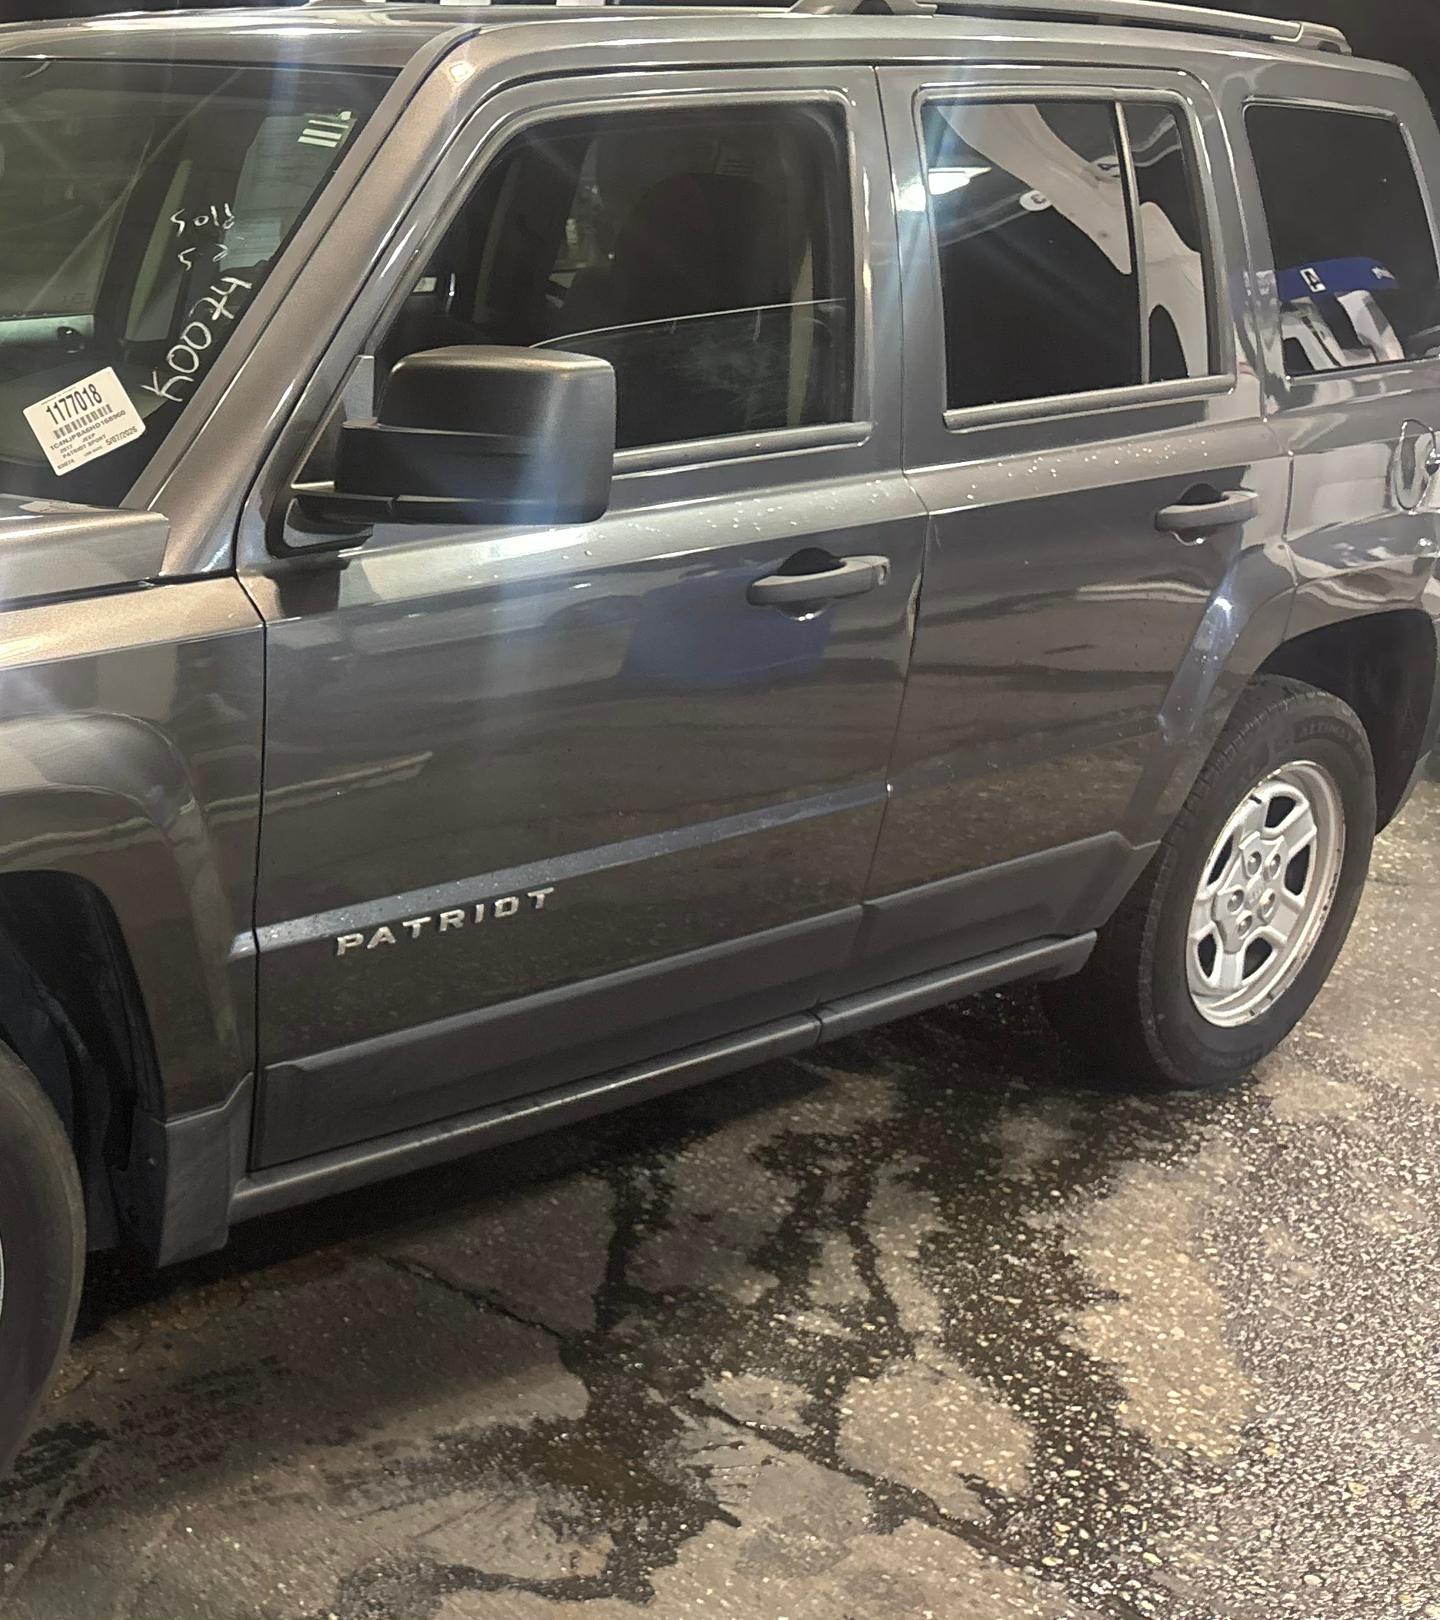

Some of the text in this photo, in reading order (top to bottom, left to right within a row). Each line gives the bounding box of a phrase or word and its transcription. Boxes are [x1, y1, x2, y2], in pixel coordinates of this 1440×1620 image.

[139, 276, 252, 402] K0074
[46, 383, 103, 425] 1177018
[62, 444, 87, 459] PATRIOT
[335, 886, 555, 957] PATRIOT
